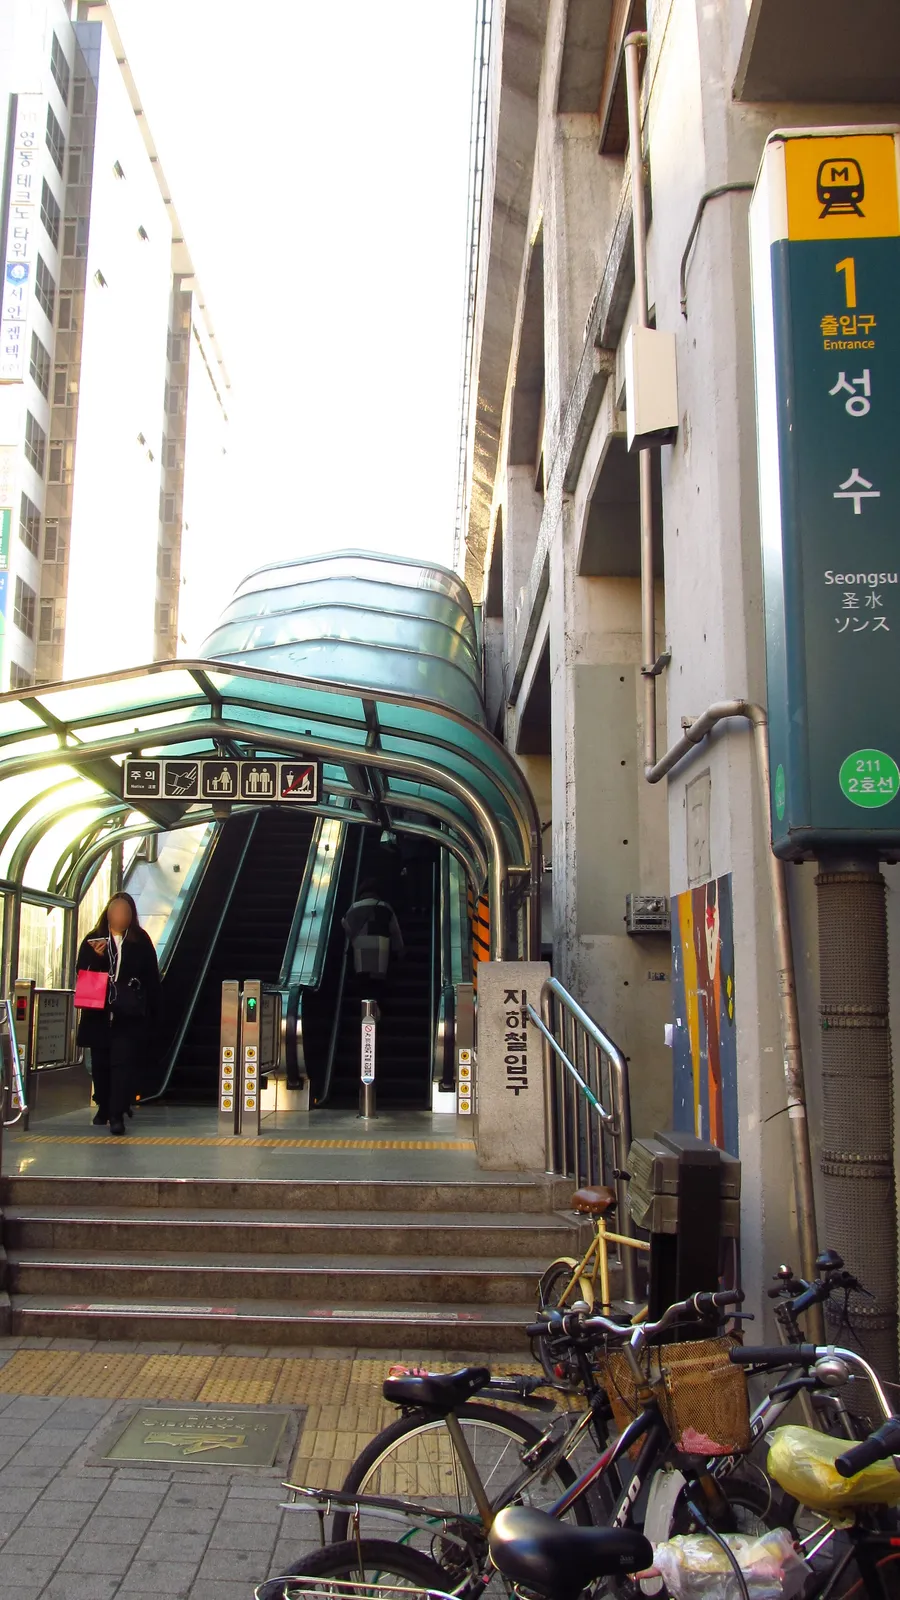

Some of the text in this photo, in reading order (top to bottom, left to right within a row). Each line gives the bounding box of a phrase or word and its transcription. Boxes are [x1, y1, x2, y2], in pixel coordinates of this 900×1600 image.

[830, 166, 850, 183] M
[835, 256, 857, 309] 1
[819, 314, 877, 337] 출입구
[823, 338, 876, 351] Entrance
[823, 569, 899, 587] Seongsu
[841, 591, 884, 610] 圣水
[834, 616, 891, 634] ソンス
[855, 759, 881, 773] 211
[847, 776, 895, 795] 2호선
[503, 989, 529, 1096] 지하철입구
